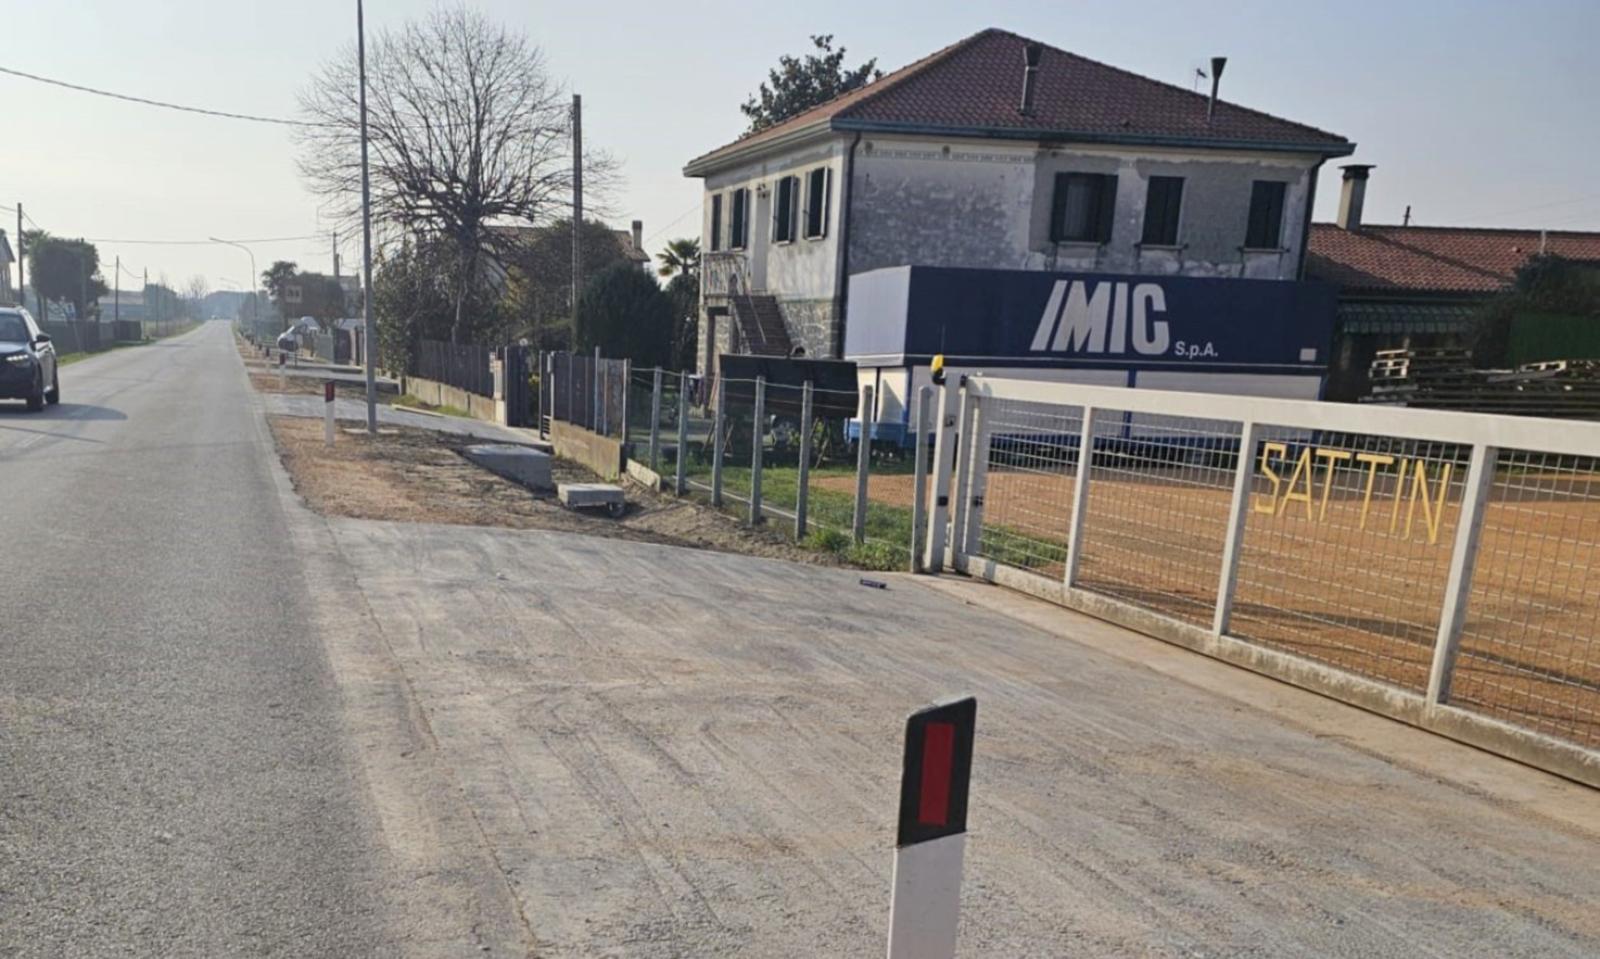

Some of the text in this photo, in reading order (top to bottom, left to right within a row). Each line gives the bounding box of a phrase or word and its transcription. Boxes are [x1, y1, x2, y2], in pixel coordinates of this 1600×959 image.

[1030, 279, 1219, 359] IMIC S.p.A.
[1254, 442, 1452, 545] SATTIN
